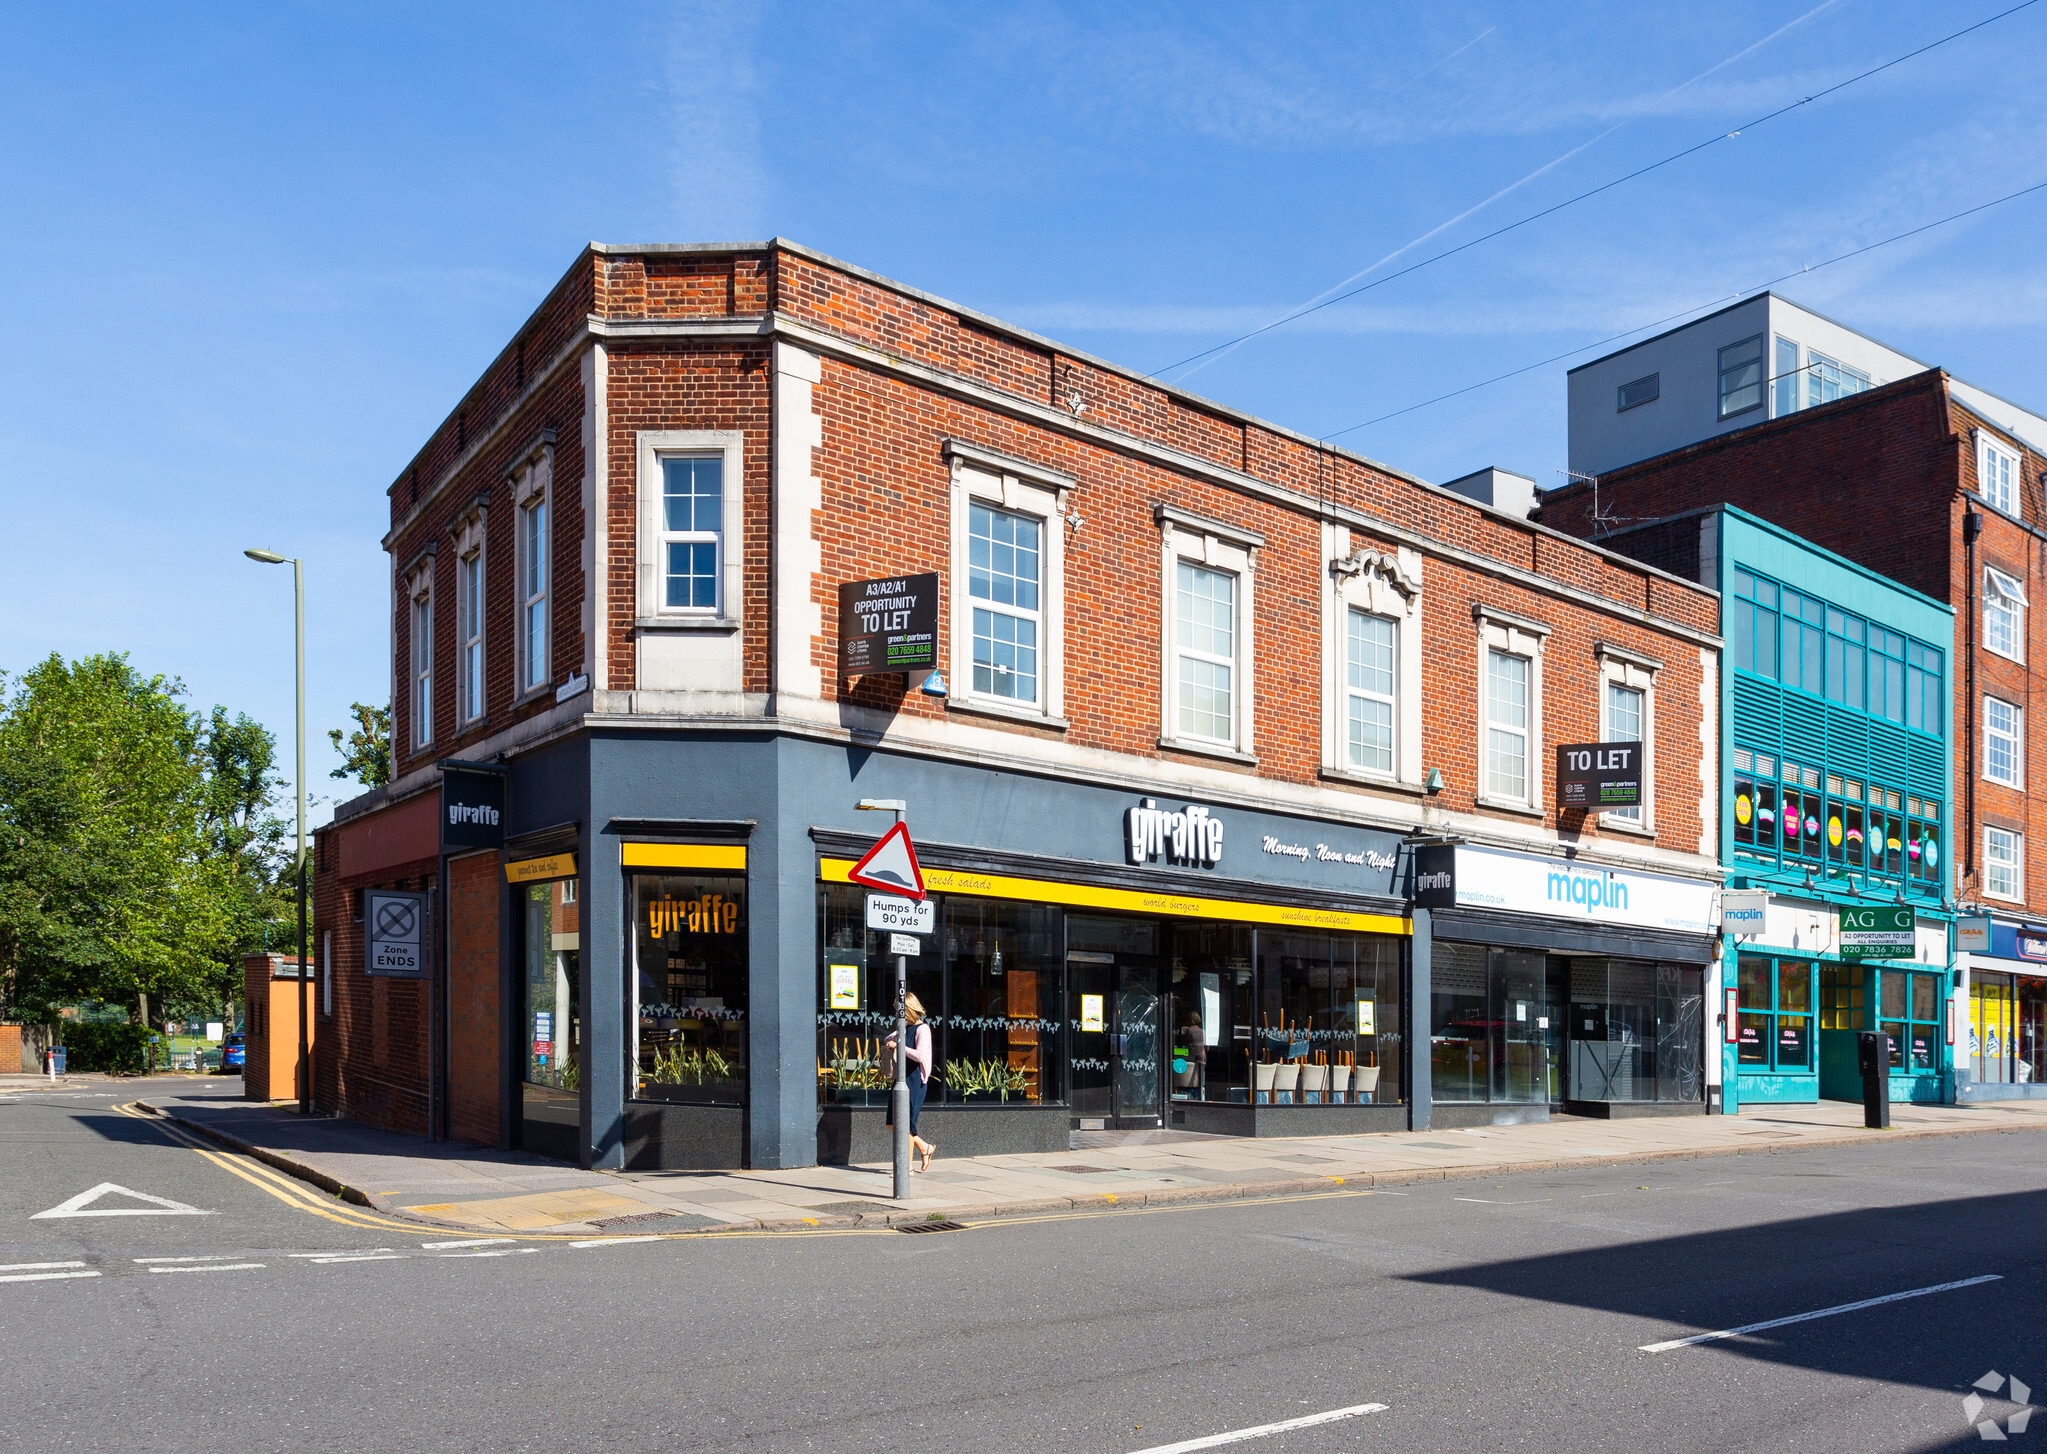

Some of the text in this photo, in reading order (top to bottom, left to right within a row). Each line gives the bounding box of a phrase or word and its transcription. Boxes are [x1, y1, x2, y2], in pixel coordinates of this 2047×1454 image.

[866, 580, 906, 596] A3/A2/A1
[854, 595, 917, 614] OPPORTUNITY
[861, 610, 911, 633] TO LET
[887, 633, 932, 644] green&partners
[887, 647, 899, 656] 020
[900, 645, 914, 655] 7659
[1567, 749, 1631, 771] TO LET
[449, 802, 499, 826] giraffe
[1129, 799, 1224, 862] giraffe
[1262, 836, 1396, 873] Morning, Noon and Night
[928, 872, 991, 889] fresh salads
[1418, 872, 1451, 891] giraffe
[1548, 870, 1628, 913] maplin
[873, 900, 928, 915] Humps for
[1143, 897, 1199, 913] world burgers
[649, 894, 738, 939] giraffe
[882, 913, 919, 926] 90 yds
[1725, 908, 1762, 922] maplin
[384, 945, 408, 954] Zone
[377, 955, 415, 966] ENDS
